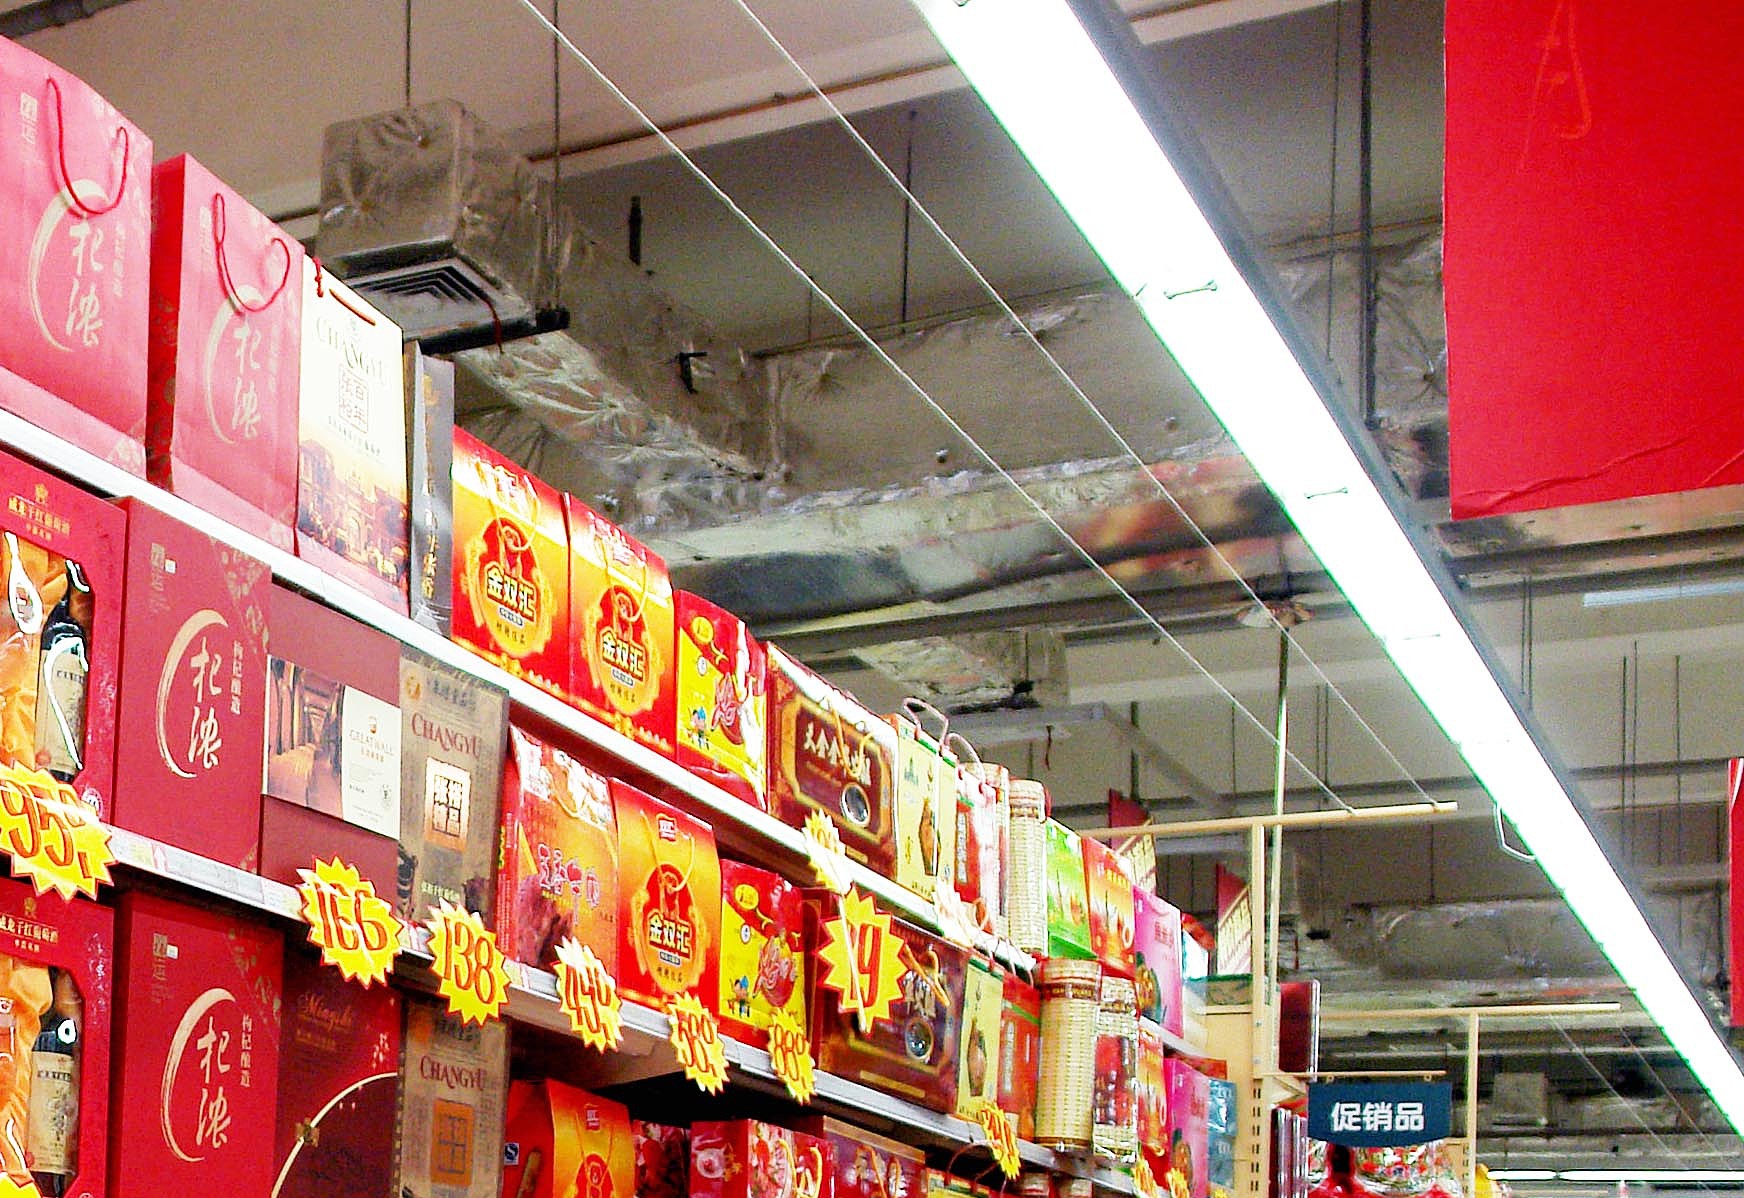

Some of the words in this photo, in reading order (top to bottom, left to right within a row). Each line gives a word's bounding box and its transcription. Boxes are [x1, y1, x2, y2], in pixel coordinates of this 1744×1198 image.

[486, 565, 536, 621] 金双汇
[601, 633, 645, 682] 金双汇
[411, 711, 482, 760] CHANGYU
[314, 880, 388, 953] 166
[649, 915, 692, 956] 金双汇
[443, 915, 497, 1006] 138
[419, 1054, 487, 1091] CHANGYU
[1330, 1101, 1425, 1133] 促销品
